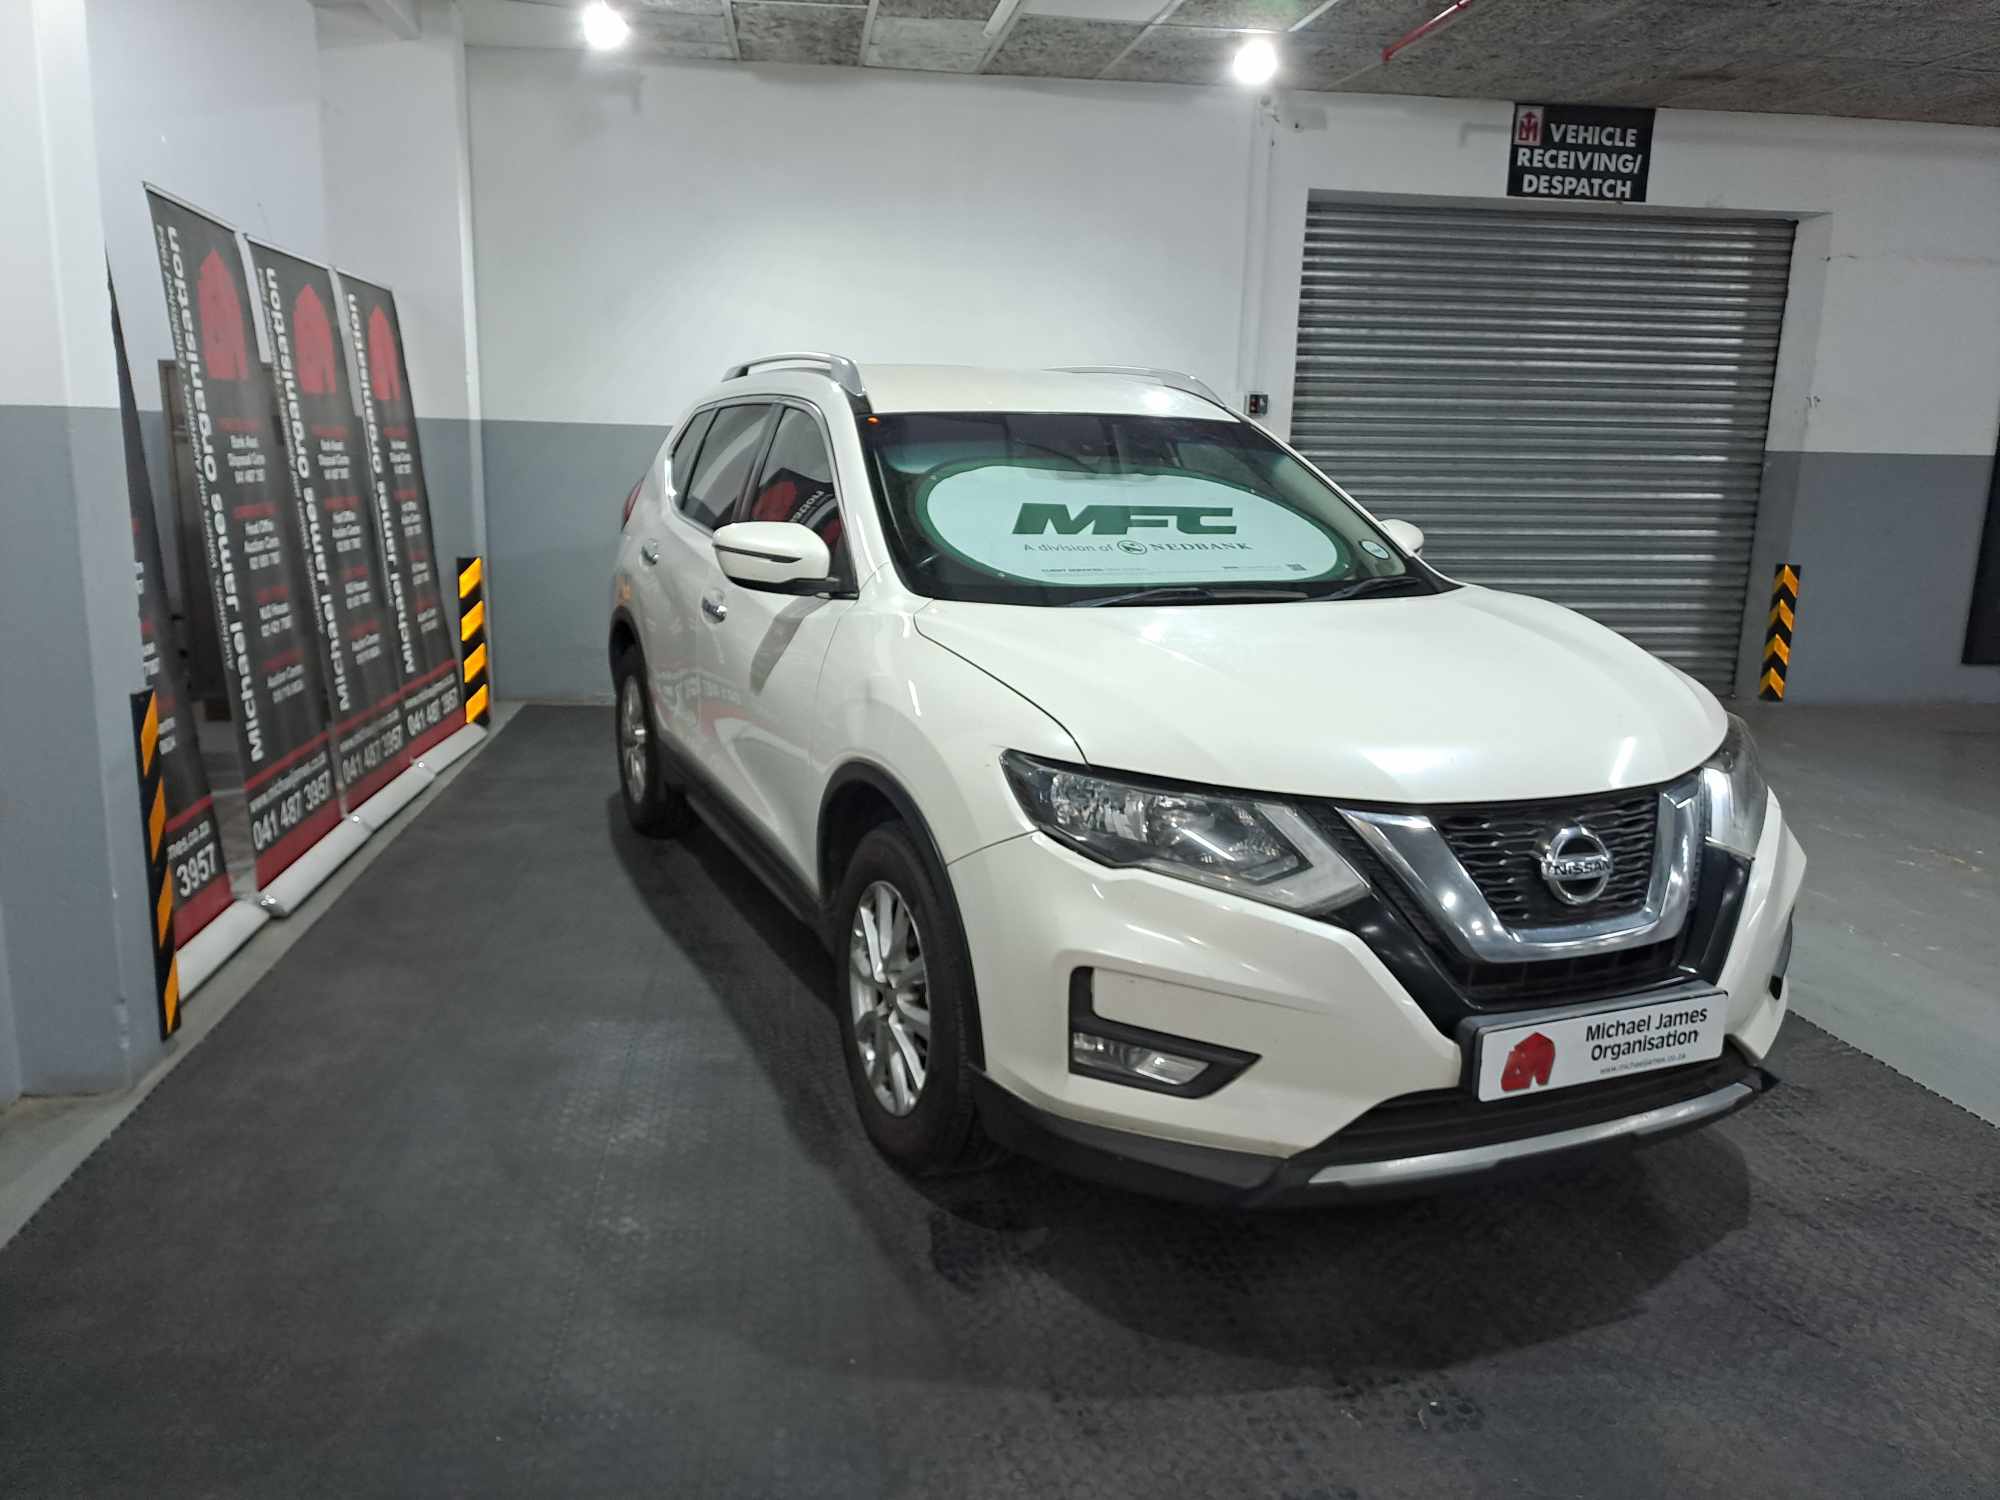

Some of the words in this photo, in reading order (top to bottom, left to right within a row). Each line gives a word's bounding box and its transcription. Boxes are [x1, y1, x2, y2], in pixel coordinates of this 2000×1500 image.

[1516, 147, 1642, 174] RECEIVING/
[1550, 123, 1637, 147] VEHICLE
[1522, 174, 1632, 199] DESPATCH
[168, 226, 218, 482] Organisation
[266, 267, 310, 479] Organisation
[211, 493, 239, 612] James
[303, 487, 330, 586] James
[376, 481, 397, 566] James
[1012, 503, 1237, 535] MFC
[1024, 543, 1037, 553] A
[1038, 543, 1097, 553] division
[1098, 543, 1114, 552] of
[1149, 542, 1254, 552] NEDBANK
[320, 594, 350, 711] Michael
[390, 573, 416, 673] Michael
[230, 621, 264, 762] Michael
[252, 808, 280, 850] 041
[280, 790, 302, 829] 487
[303, 769, 331, 811] 3957
[176, 842, 217, 897] 3957
[1553, 861, 1611, 875] NISSAN
[1585, 1014, 1652, 1043] Michael
[1655, 1008, 1708, 1031] James
[1591, 1028, 1699, 1062] Organisation
